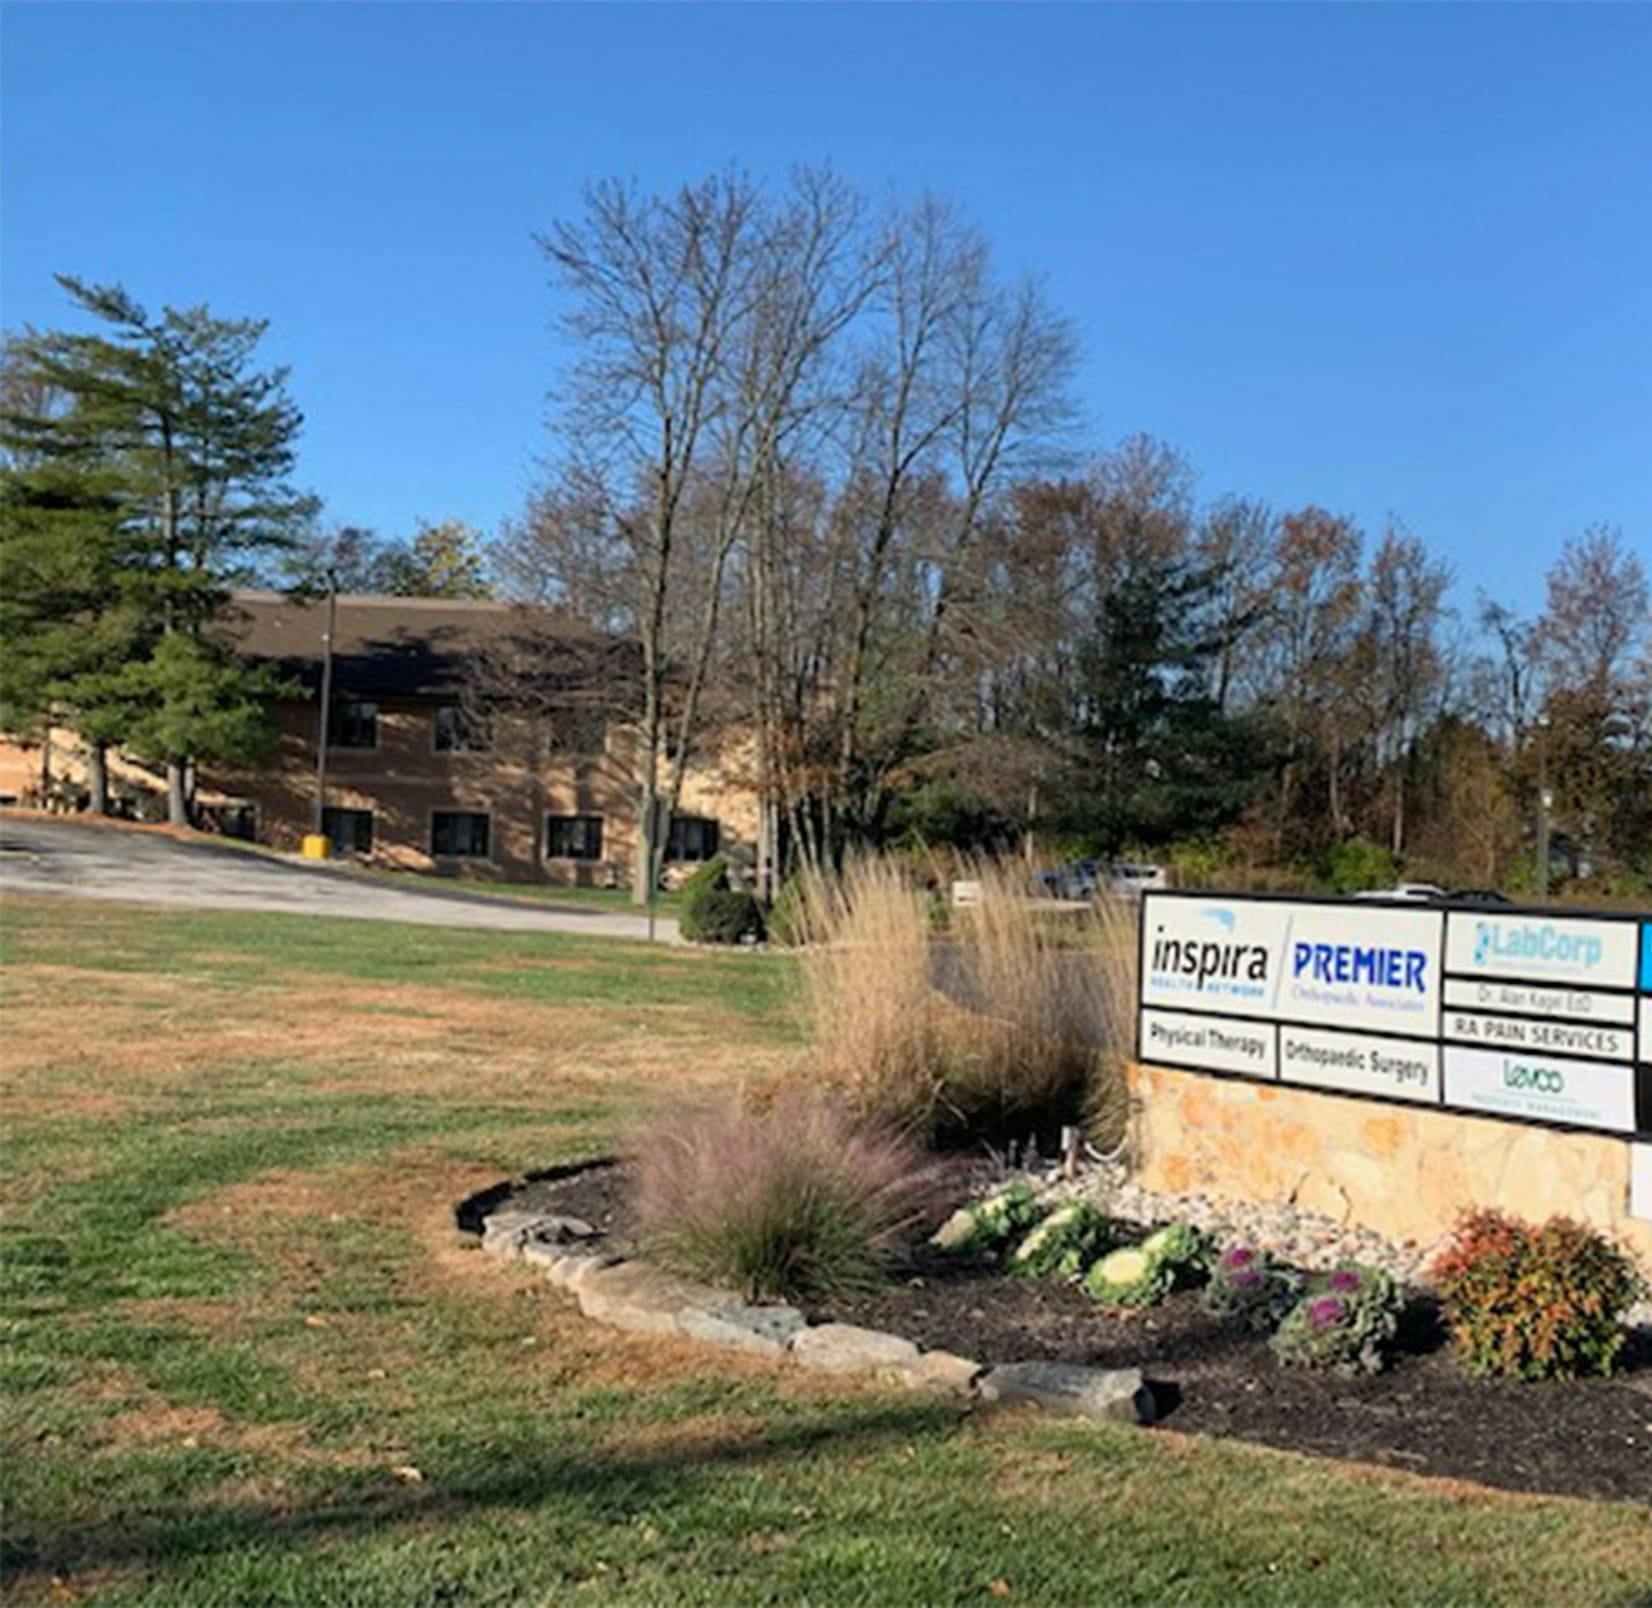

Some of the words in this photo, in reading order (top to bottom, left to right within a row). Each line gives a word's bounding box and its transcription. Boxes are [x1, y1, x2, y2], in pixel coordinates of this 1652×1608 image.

[1151, 925, 1268, 991] inspira
[1492, 923, 1602, 968] LabCorp
[1294, 942, 1427, 994] PREMIER
[1150, 1021, 1206, 1047] Physical
[1208, 1028, 1267, 1060] Therapy
[1455, 1018, 1479, 1035] RA
[1484, 1021, 1526, 1042] PAIN
[1531, 1026, 1620, 1053] SERVICES
[1369, 1050, 1429, 1086] Surgery
